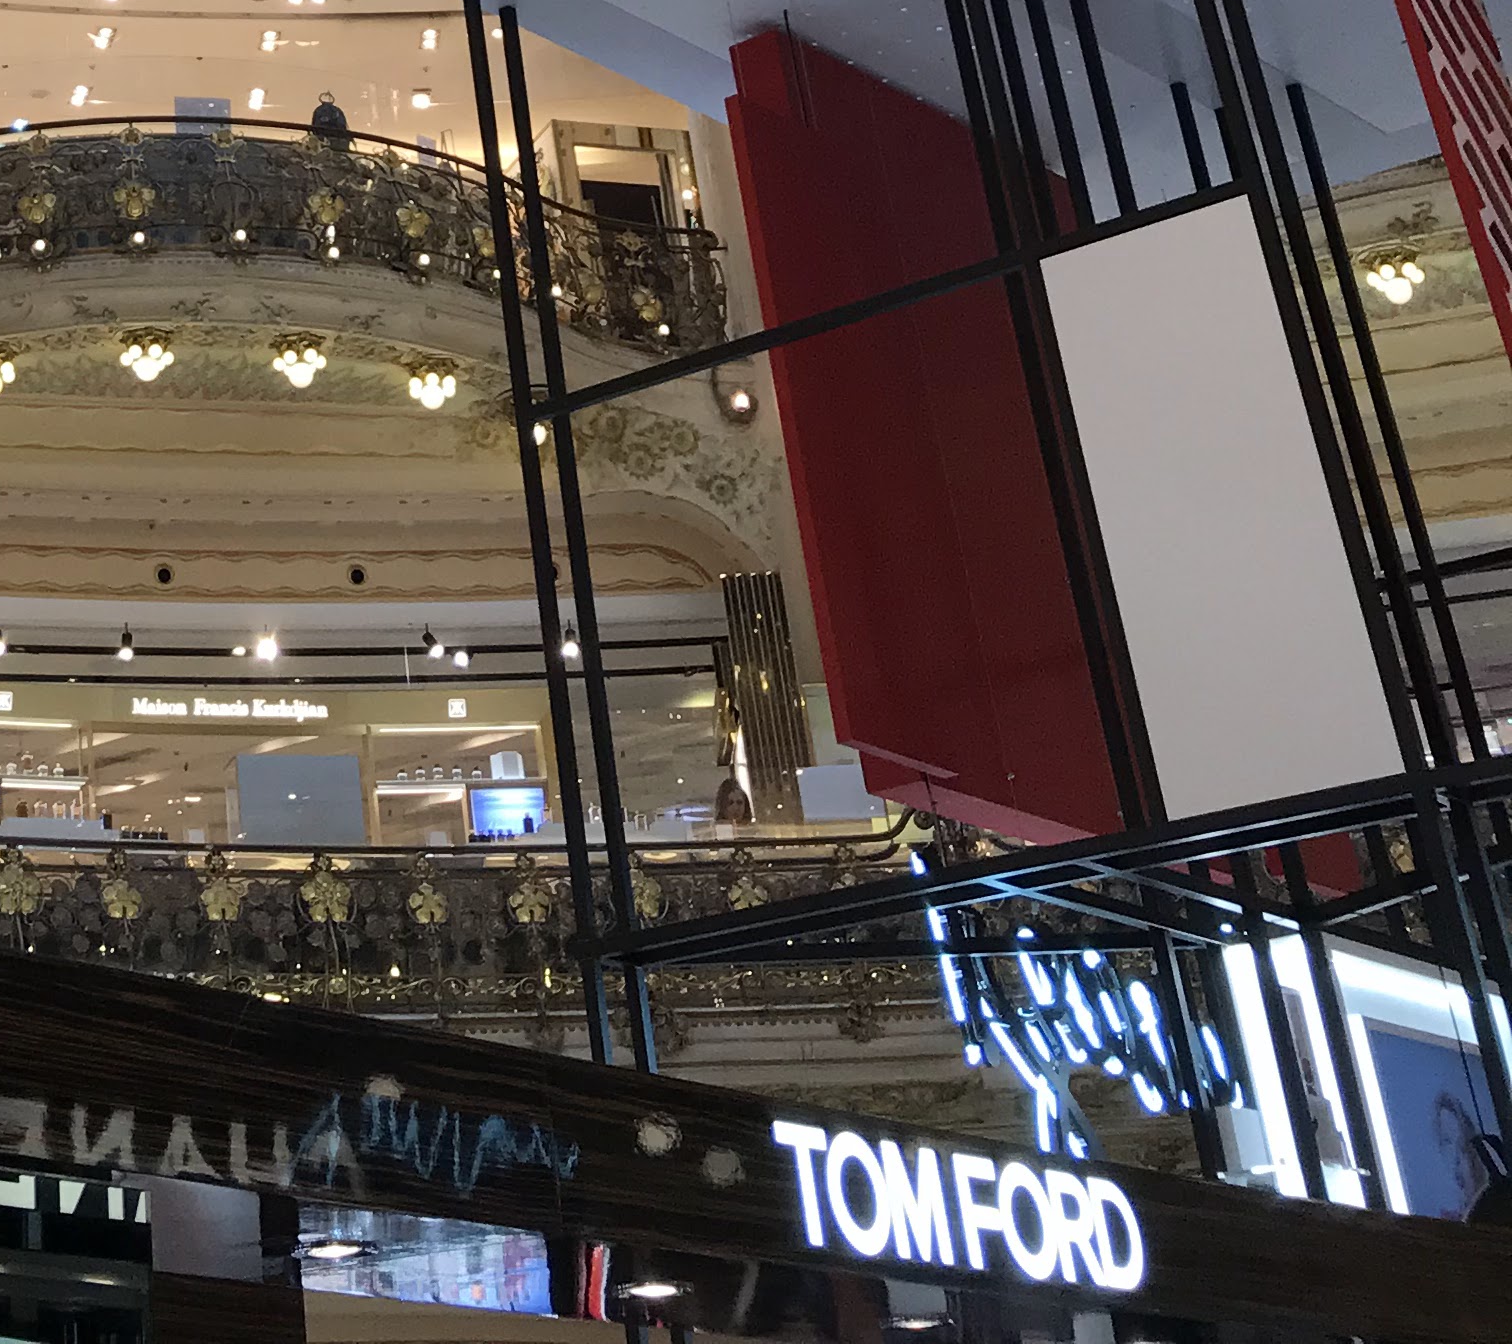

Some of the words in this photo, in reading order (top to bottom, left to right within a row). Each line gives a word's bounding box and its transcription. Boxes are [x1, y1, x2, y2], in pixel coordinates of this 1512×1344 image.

[132, 698, 187, 715] Maison
[193, 698, 249, 716] Francis
[772, 1120, 954, 1266] TOM
[952, 1152, 1145, 1291] FORD
